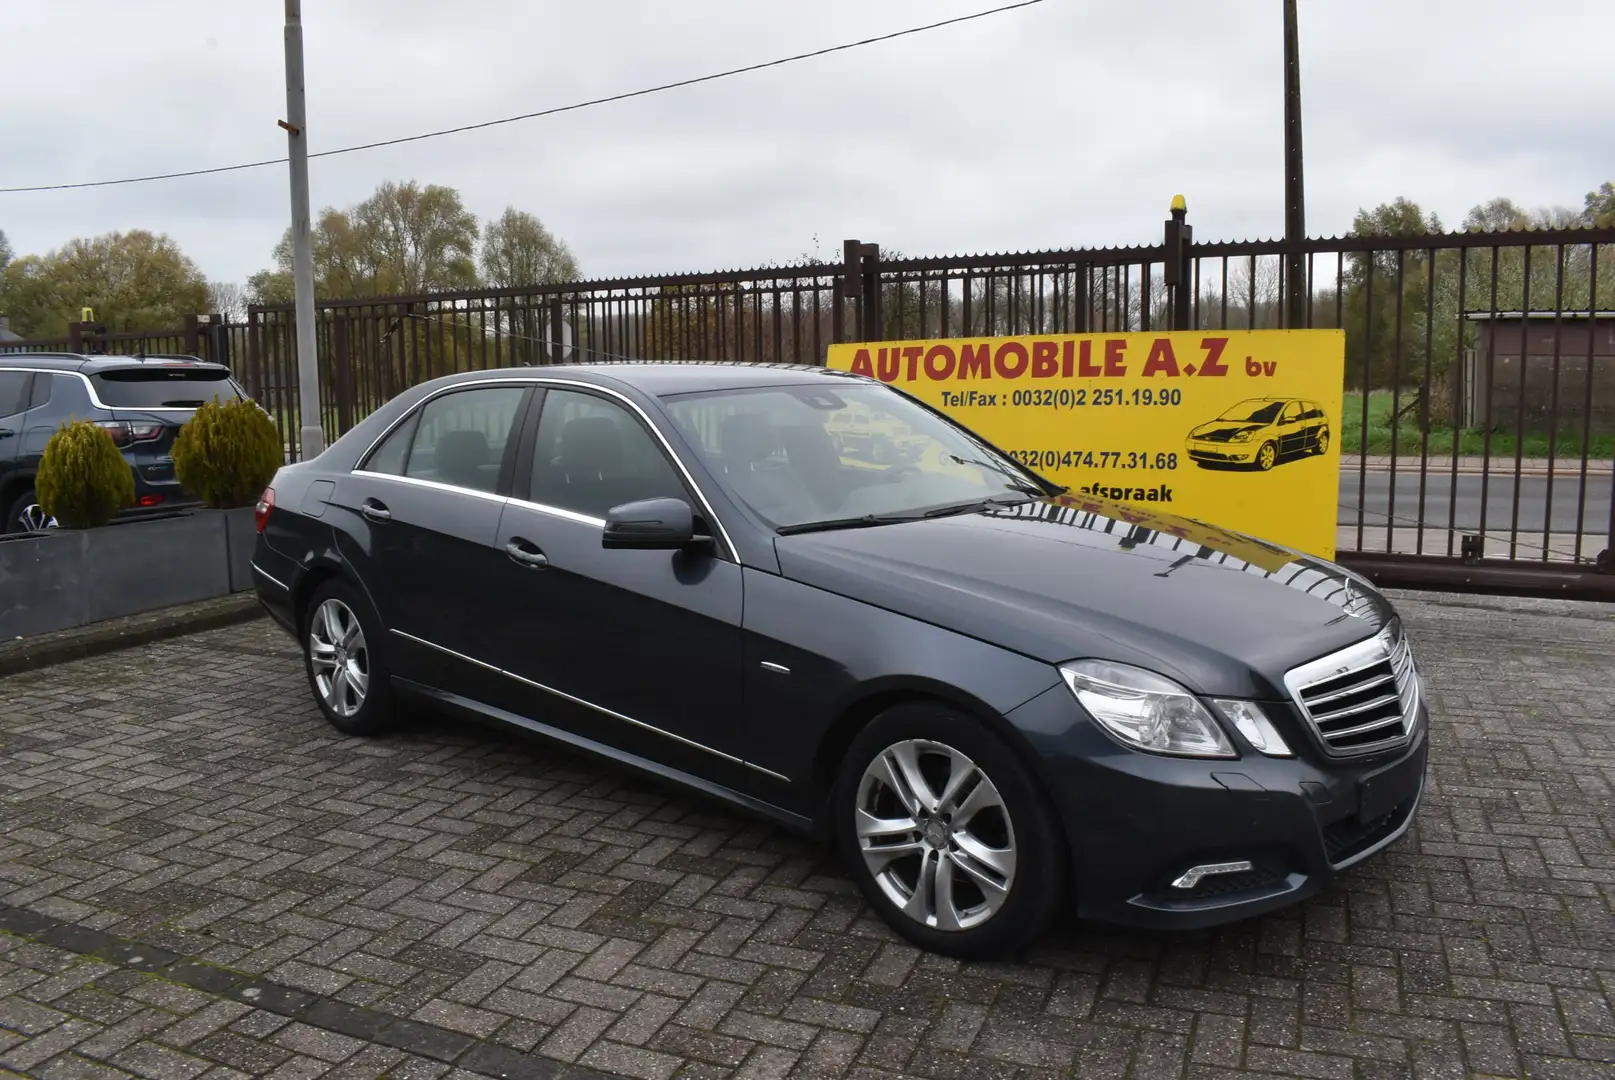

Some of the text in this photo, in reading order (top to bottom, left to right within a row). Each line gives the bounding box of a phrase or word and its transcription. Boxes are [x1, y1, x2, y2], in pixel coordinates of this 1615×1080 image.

[850, 337, 1277, 382] AUTOMOBILE A.Z bv
[941, 390, 996, 408] Tel/Fax
[1012, 388, 1087, 411] 0032(0)2
[1091, 388, 1182, 406] 251.19.90
[1005, 450, 1178, 472] 032(0)474.77.31.68
